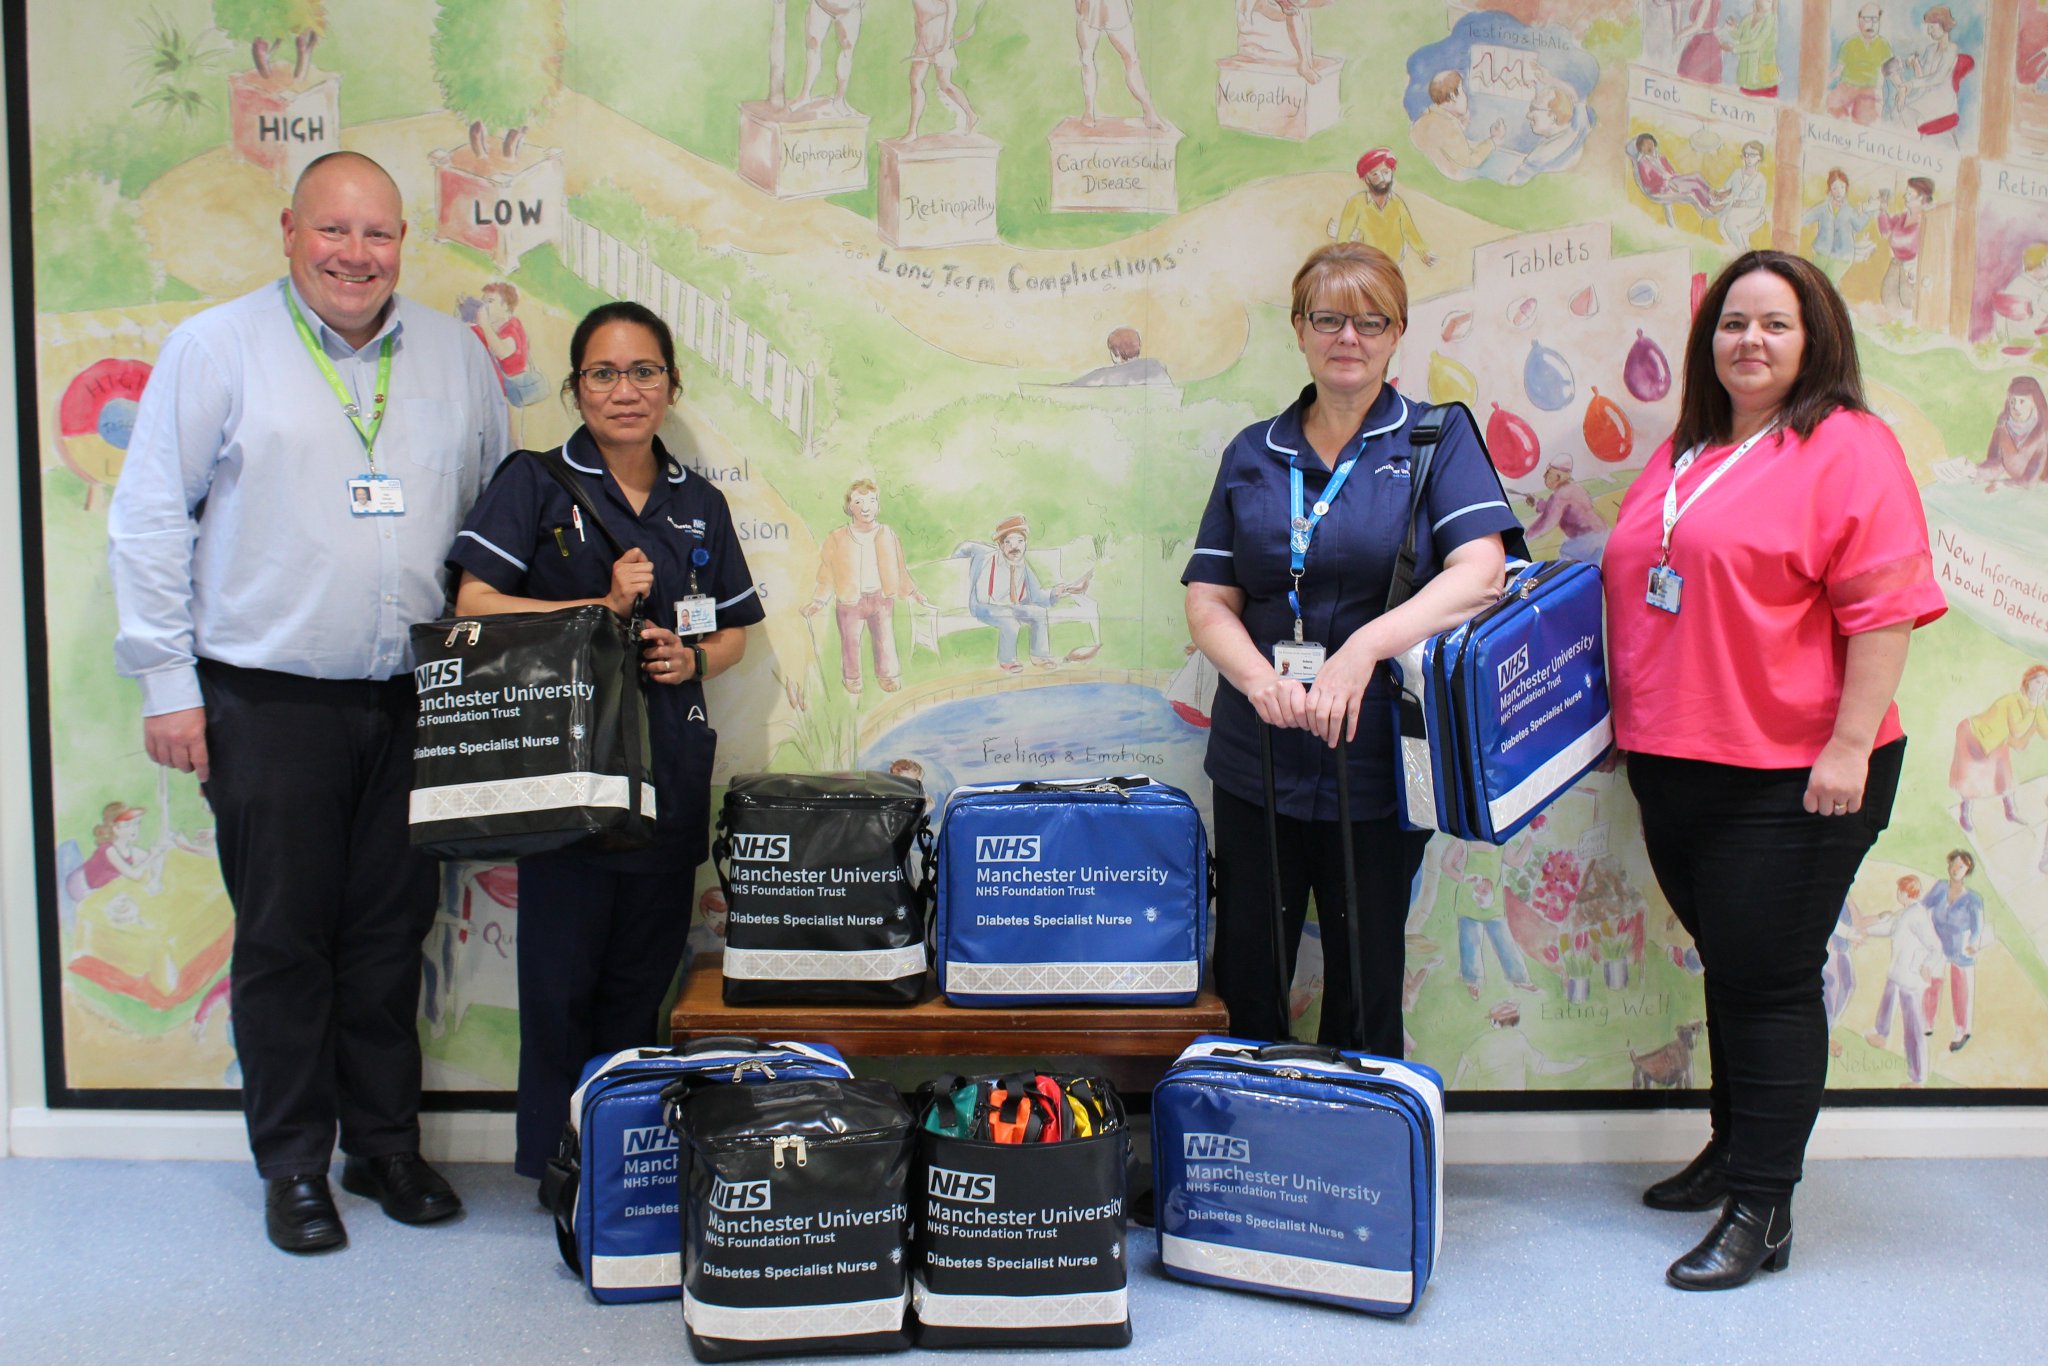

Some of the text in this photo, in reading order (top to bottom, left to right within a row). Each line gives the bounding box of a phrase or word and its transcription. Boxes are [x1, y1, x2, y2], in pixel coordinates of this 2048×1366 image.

[1465, 23, 1519, 44] Testing
[1217, 81, 1301, 117] Neuropathy
[1644, 78, 1756, 123] Foot Exam
[259, 115, 324, 143] HIGH
[784, 143, 863, 173] Nephropathy
[1057, 147, 1173, 172] Cardiovascular
[1808, 122, 1944, 173] Kidney Functions
[1082, 175, 1148, 193] Disease
[475, 199, 543, 226] LOW
[906, 195, 994, 225] Retinopathy
[1504, 238, 1589, 278] Tablets
[877, 249, 1177, 298] Long Term Complications
[680, 456, 749, 482] tural
[1938, 529, 2048, 603] New Informatio
[1942, 562, 1984, 598] About
[415, 660, 461, 692] NHS
[1499, 645, 1528, 691] NHS
[1500, 634, 1594, 712] Manchester University
[420, 681, 595, 712] anchester University
[1501, 674, 1562, 726] NHS Foundation Trust
[427, 711, 489, 726] Foundation
[491, 706, 521, 719] Trust
[1501, 690, 1582, 754] Diabetes Specialist Nurse
[459, 737, 520, 755] Specialist
[522, 735, 560, 748] Nurse
[983, 736, 1055, 768] Feelings
[1085, 744, 1164, 765] Emotions
[733, 836, 788, 860] NHS
[978, 837, 1039, 861] NHS
[731, 866, 827, 883] Manchester
[976, 866, 1169, 886] Manchester University
[752, 885, 815, 897] Foundation
[817, 886, 846, 897] Trust
[976, 885, 1096, 896] NHS Foundation Trust
[730, 912, 884, 927] Diabetes Specialist Nurse
[976, 914, 1132, 928] Diabetes Specialist Nurse
[1541, 993, 1669, 1026] Eating Well
[1186, 1134, 1247, 1160] NHS
[624, 1177, 648, 1189] NHS
[711, 1177, 768, 1210] NHS
[930, 1169, 993, 1201] NHS
[1186, 1164, 1381, 1205] Manchester University
[1186, 1183, 1308, 1204] NHS Foundation Trust
[708, 1203, 908, 1233] Manchester University
[928, 1198, 1122, 1225] Manchester University
[1188, 1209, 1344, 1240] Diabetes Specialist Nurse
[705, 1230, 835, 1248] NHS Foundation Trust
[927, 1220, 1057, 1239] NHS Foundation Trust
[703, 1261, 877, 1280] Diabetes Specialist Nurse
[927, 1252, 1097, 1271] Diabetes Specialist Nurse
